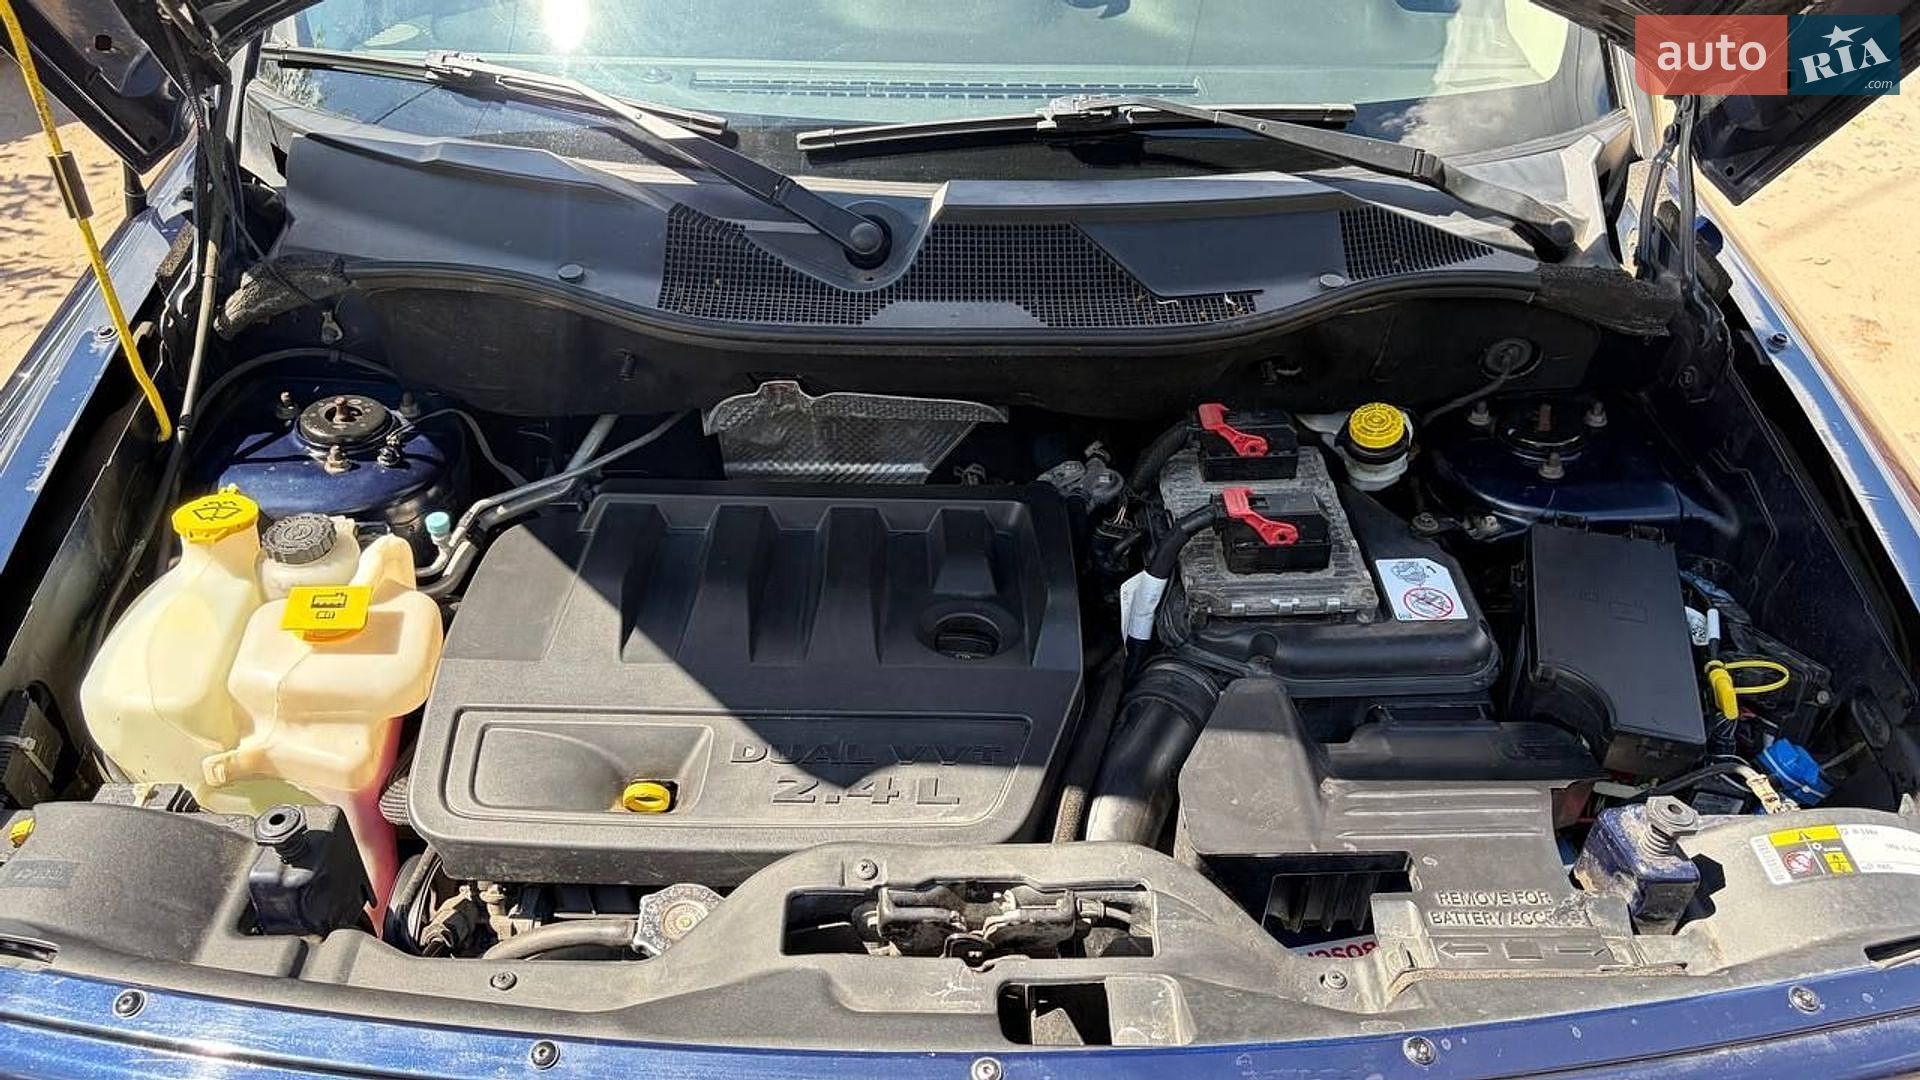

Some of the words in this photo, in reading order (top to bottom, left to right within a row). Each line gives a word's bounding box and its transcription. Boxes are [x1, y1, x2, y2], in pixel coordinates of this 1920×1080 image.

[730, 742, 876, 765] DUAL
[889, 743, 1005, 766] VVT
[772, 775, 960, 805] 2.4L
[1437, 890, 1511, 906] REMOVE
[1513, 890, 1552, 906] FOR
[1429, 911, 1504, 926] BATTERY
